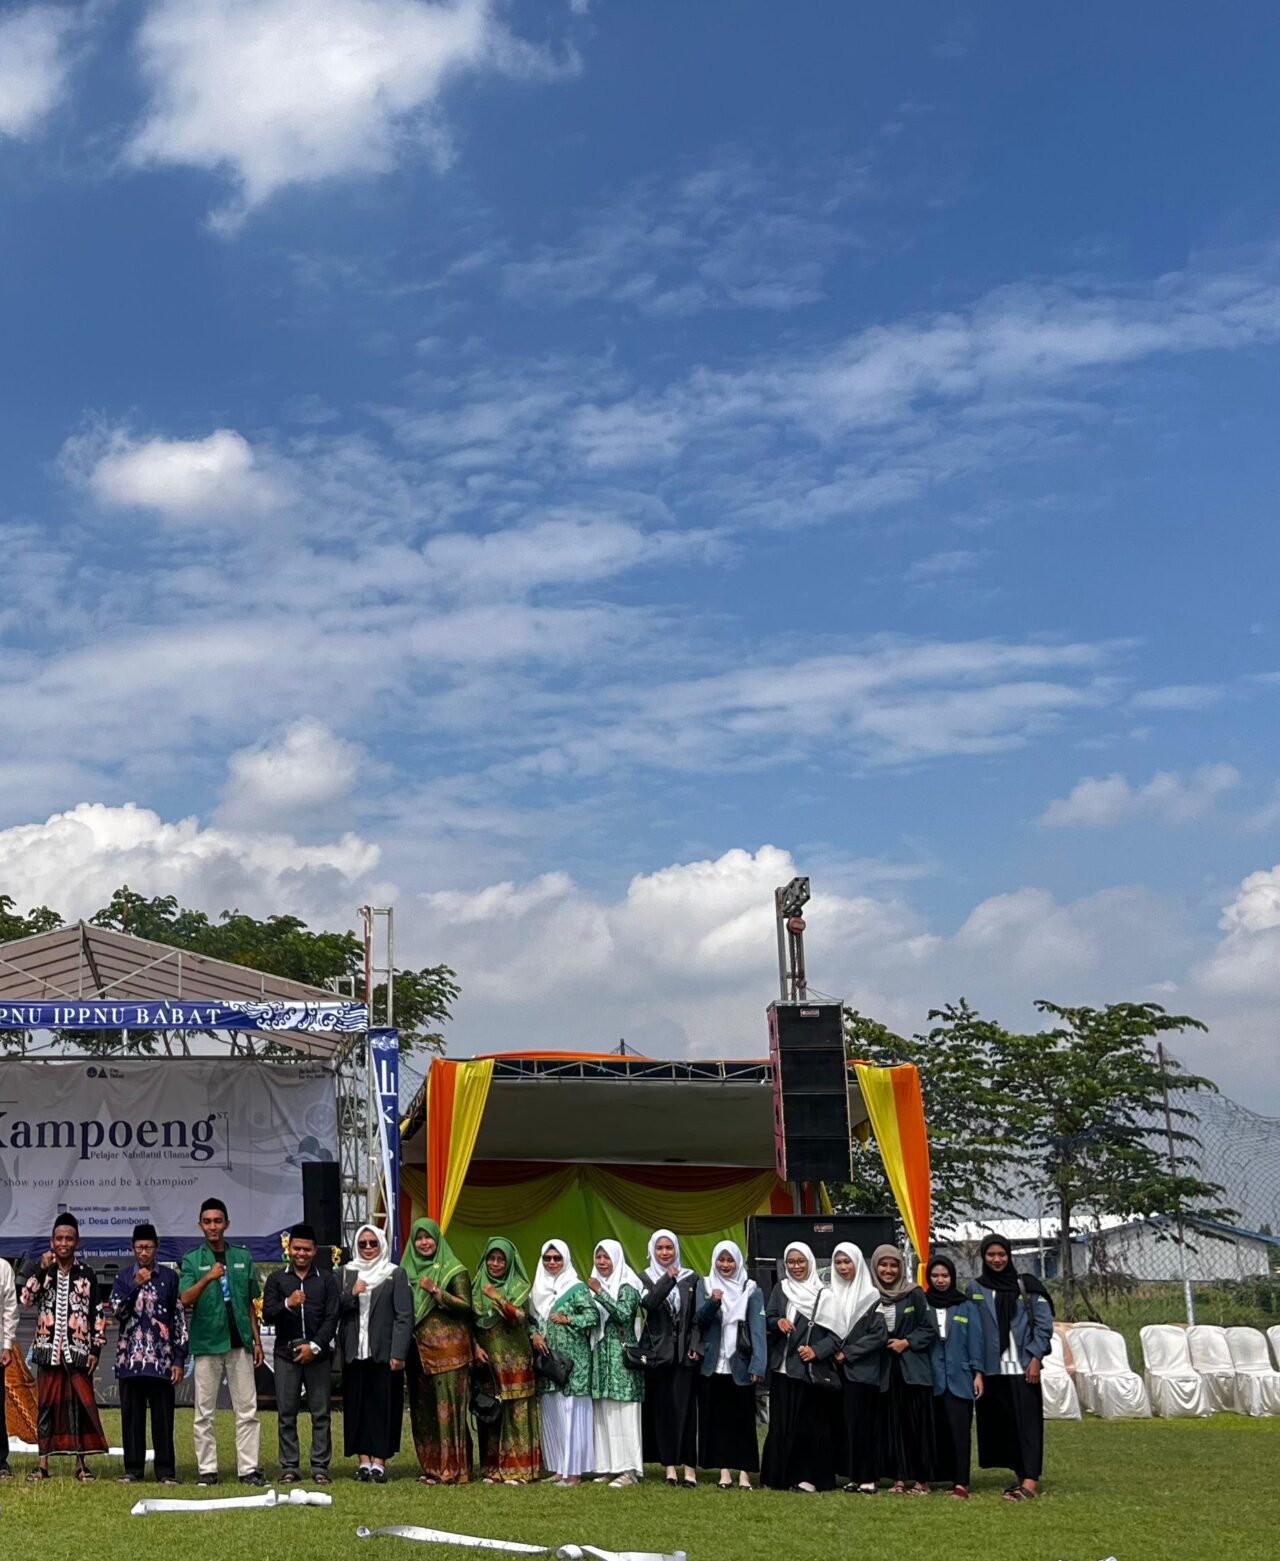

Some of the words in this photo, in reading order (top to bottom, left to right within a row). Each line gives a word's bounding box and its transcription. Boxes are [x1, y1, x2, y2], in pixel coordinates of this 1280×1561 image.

[53, 1008, 125, 1024] IPPNU
[136, 1008, 221, 1025] BABAT
[90, 1151, 119, 1160] Pelajar
[163, 1150, 190, 1159] Ulama
[32, 1178, 54, 1189] your
[58, 1177, 95, 1188] passion
[98, 1177, 117, 1187] and
[120, 1177, 132, 1187] be
[89, 1217, 109, 1225] Desa
[110, 1216, 150, 1226] Gembong
